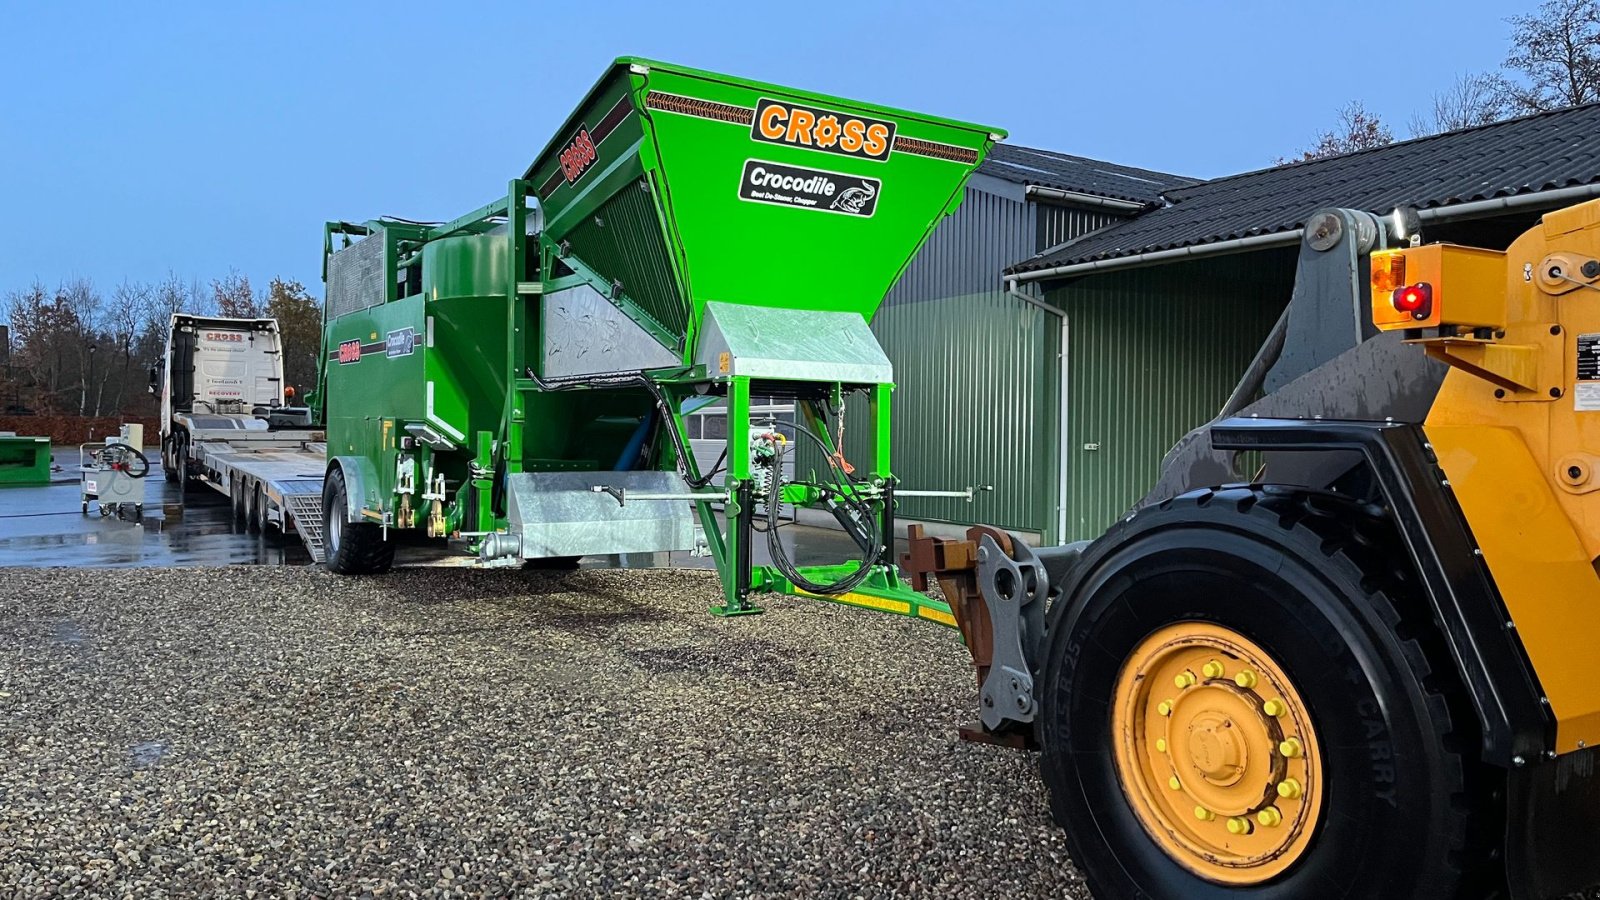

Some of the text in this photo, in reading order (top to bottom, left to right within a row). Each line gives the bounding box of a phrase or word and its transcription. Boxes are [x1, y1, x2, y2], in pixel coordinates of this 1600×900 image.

[760, 104, 888, 156] CROSS
[560, 129, 595, 182] CROSS
[750, 167, 835, 196] Crocodile
[793, 196, 817, 206] Chopper
[206, 333, 242, 343] CROSS
[340, 341, 360, 363] CROSS
[1355, 698, 1398, 808] CARRY
